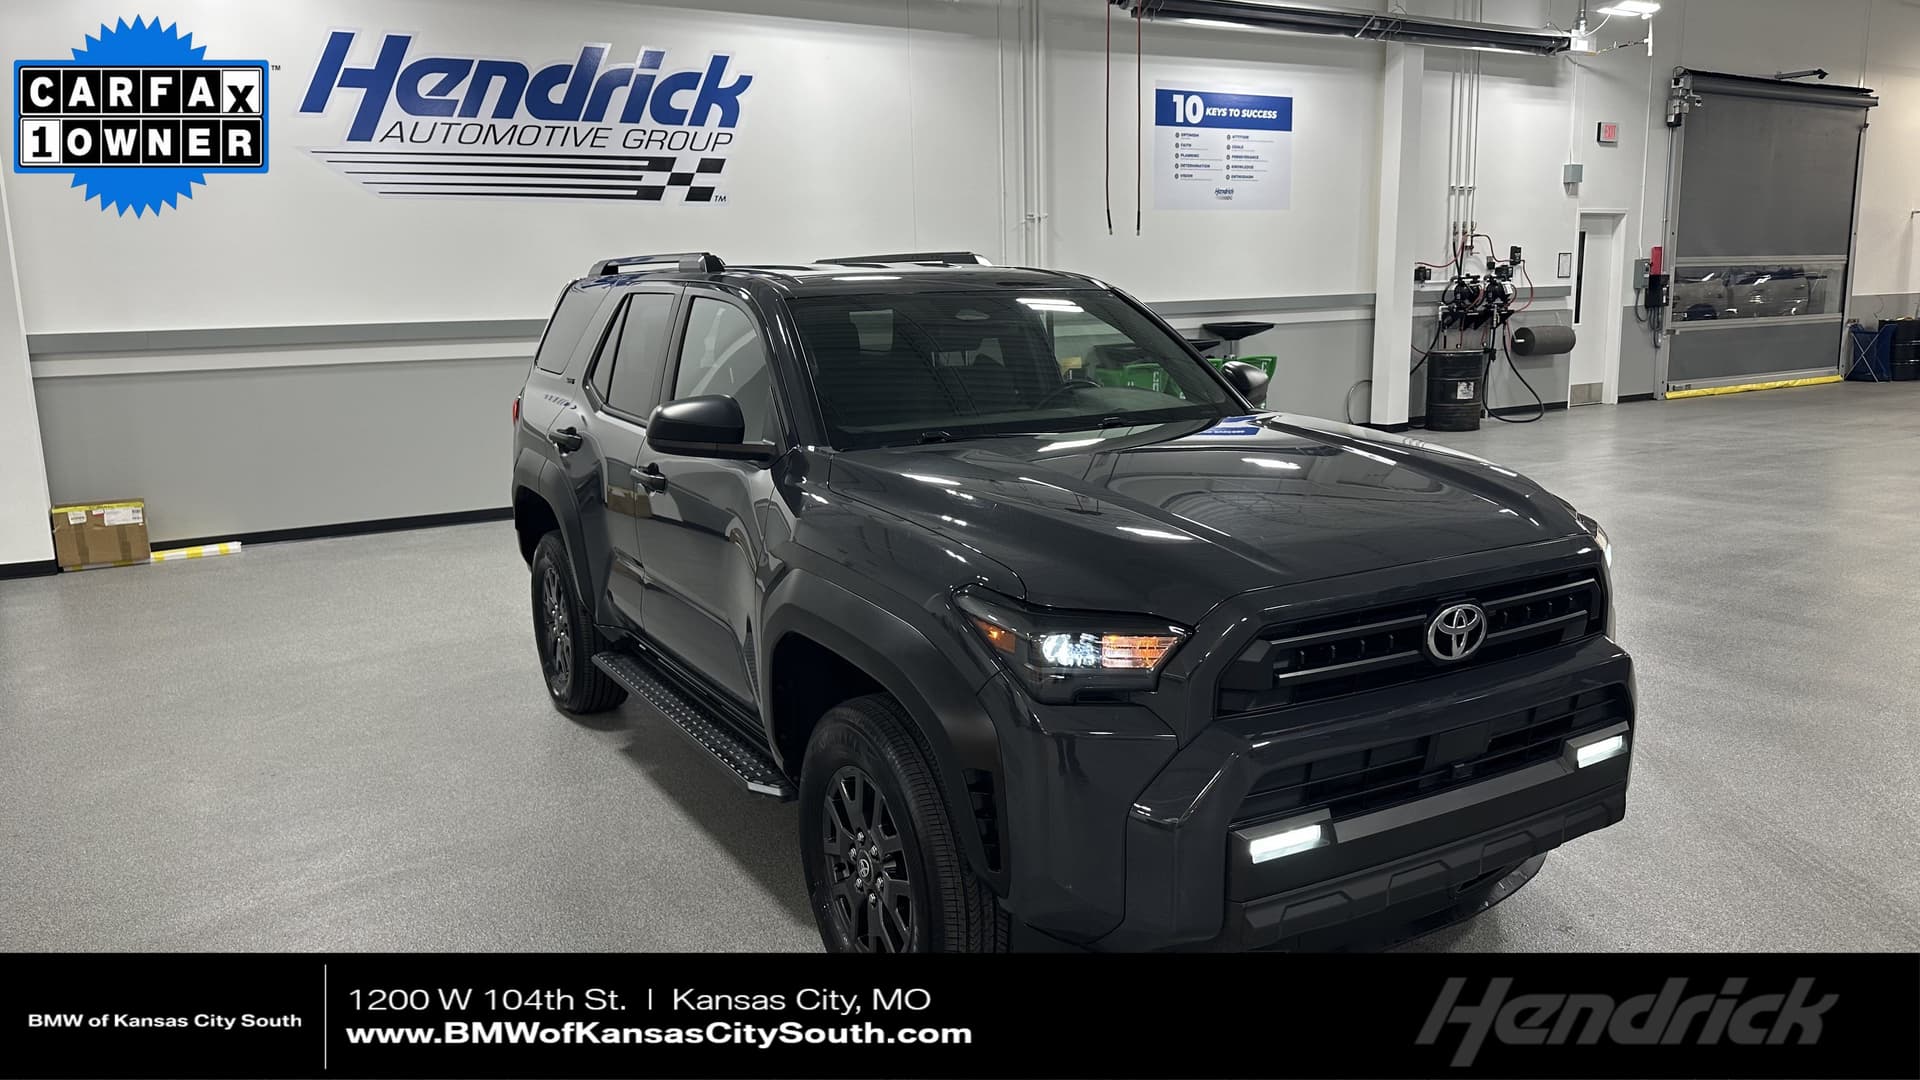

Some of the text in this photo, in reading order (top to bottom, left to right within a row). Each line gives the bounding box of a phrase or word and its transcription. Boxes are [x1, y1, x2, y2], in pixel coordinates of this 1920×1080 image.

[300, 31, 752, 142] Hendrick
[1172, 94, 1278, 124] 10 KEYS TO SUCCESS
[379, 121, 733, 152] AUTOMOTIVE GROUP
